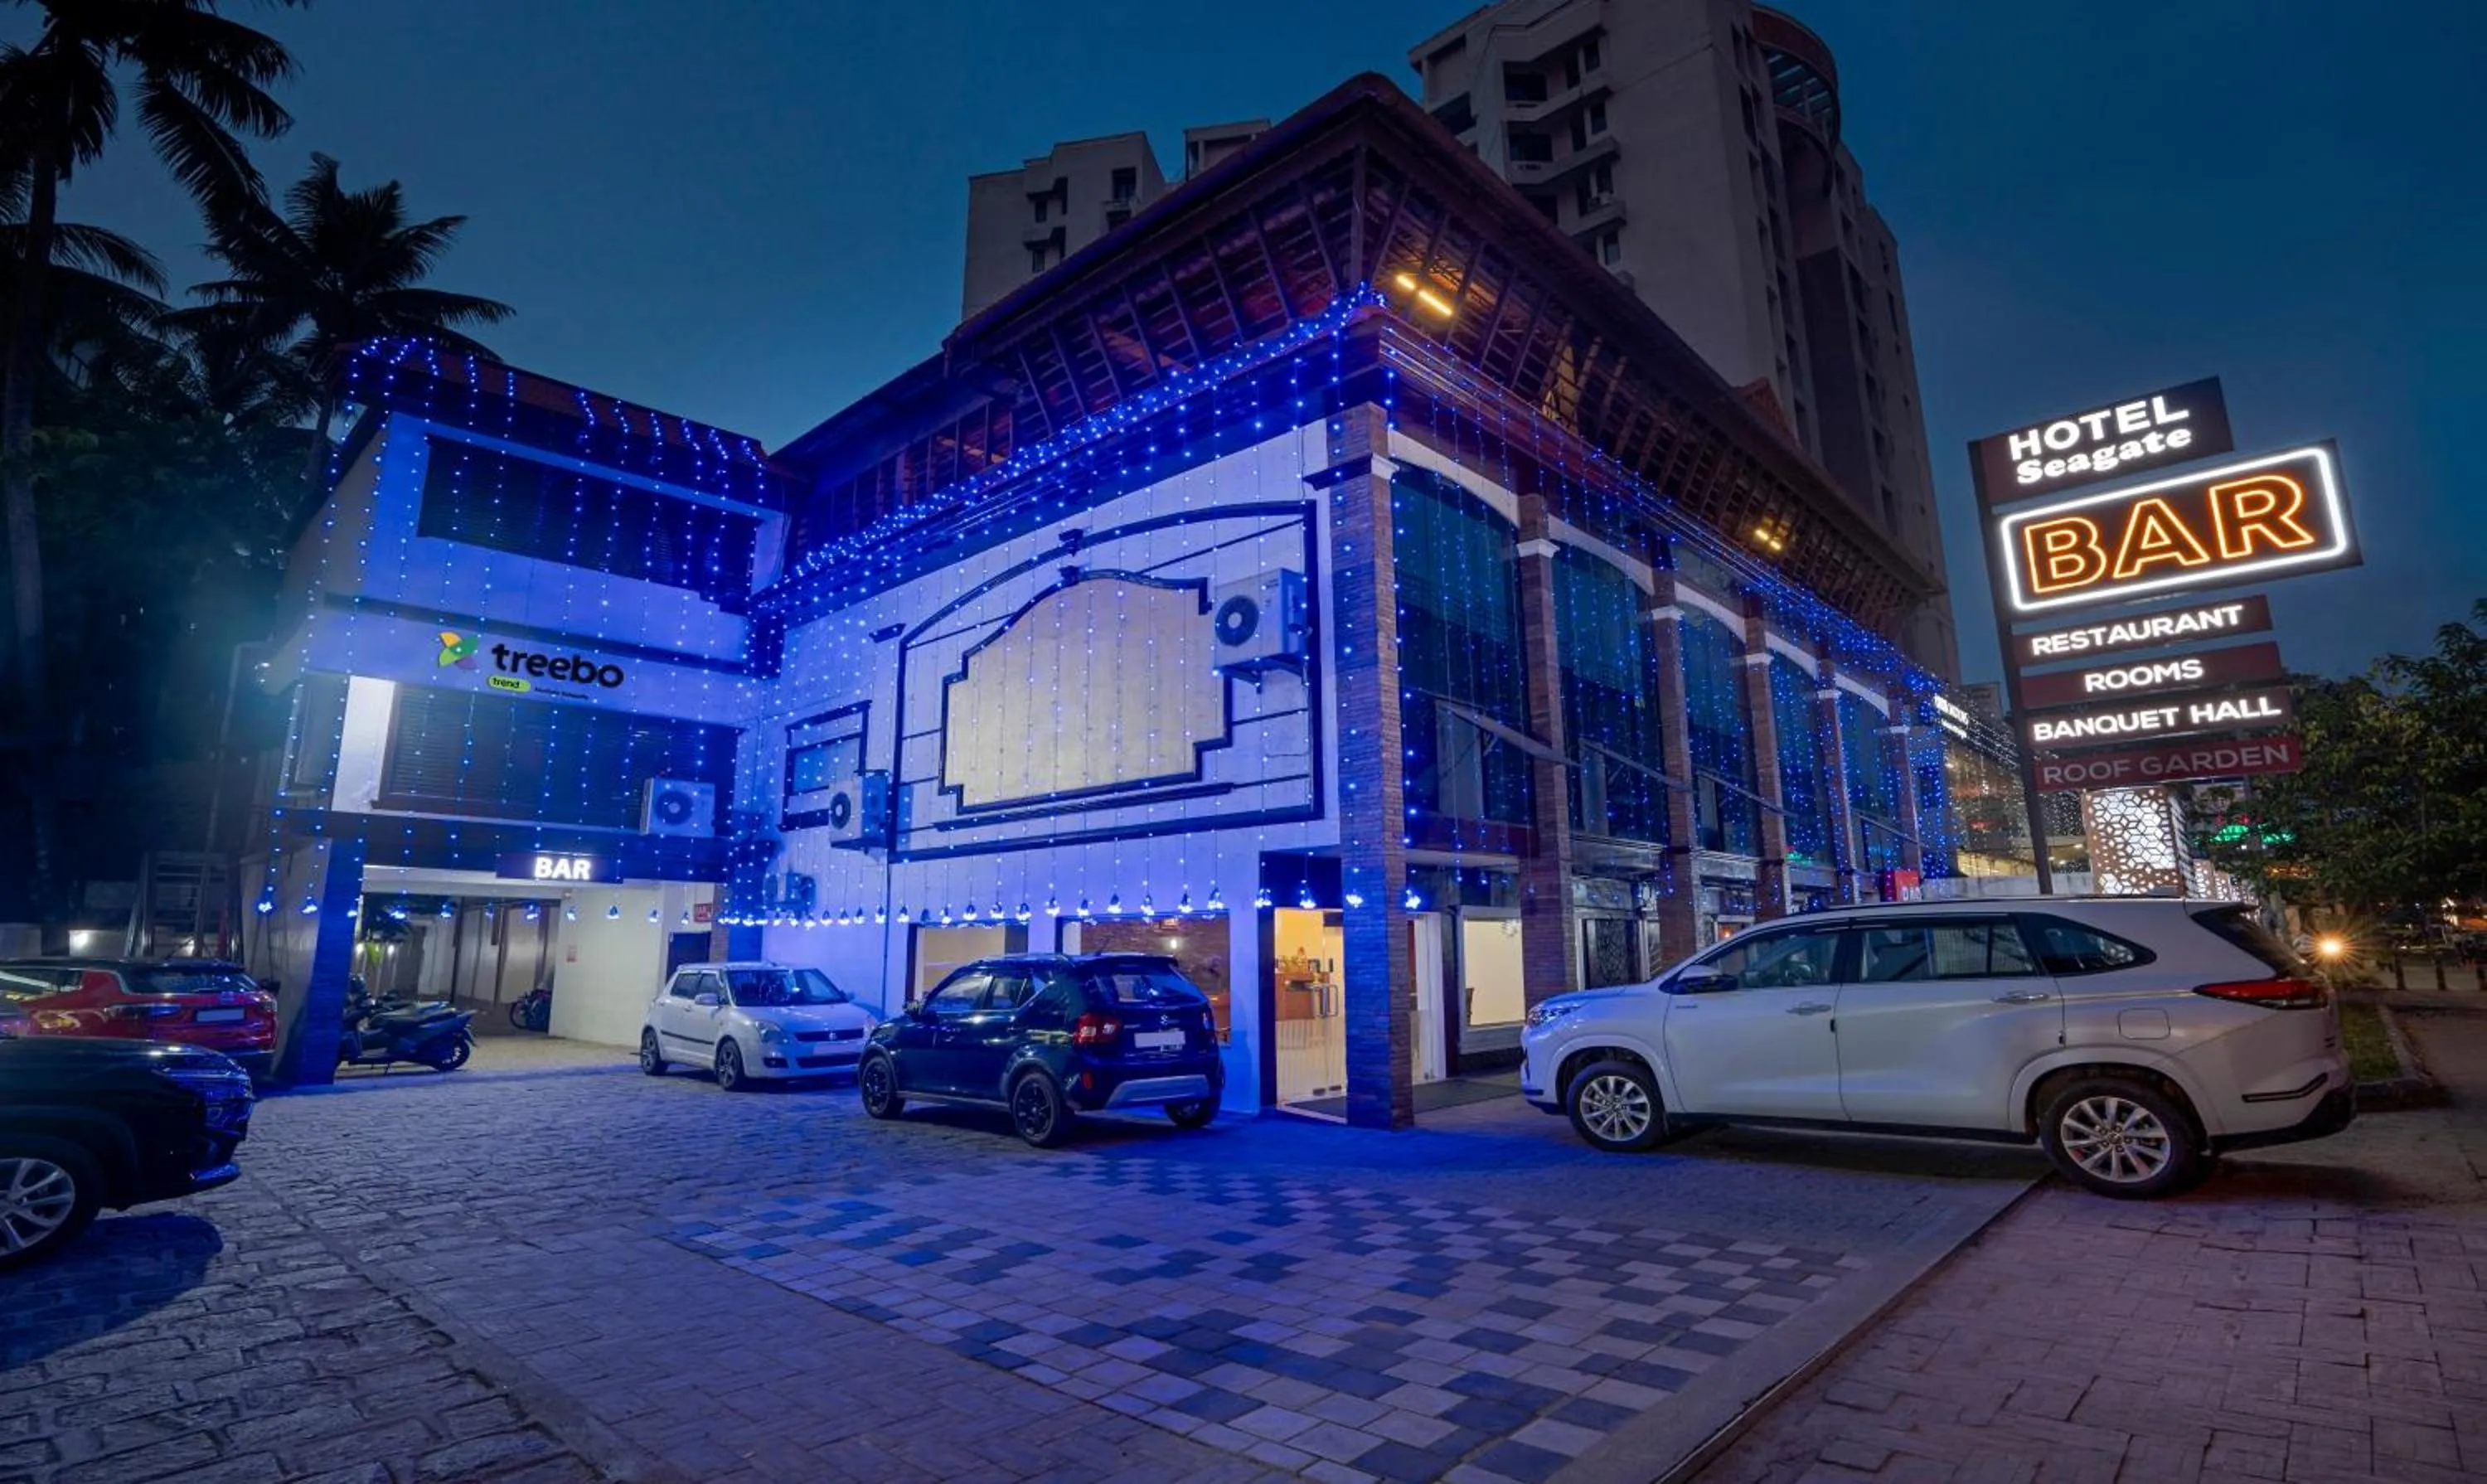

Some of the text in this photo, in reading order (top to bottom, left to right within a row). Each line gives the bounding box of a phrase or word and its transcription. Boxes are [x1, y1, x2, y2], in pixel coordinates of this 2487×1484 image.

[2008, 394, 2190, 462] HOTEL
[2015, 426, 2193, 485] Seagate
[2024, 474, 2315, 594] BAR
[2031, 604, 2244, 656] RESTAURANT
[491, 642, 625, 689] treebo
[492, 677, 521, 689] trend
[2084, 659, 2205, 693] ROOMS
[2033, 696, 2282, 742] BANQUET HALL
[2043, 744, 2291, 786] ROOF GARDEN
[534, 856, 592, 880] BAR
